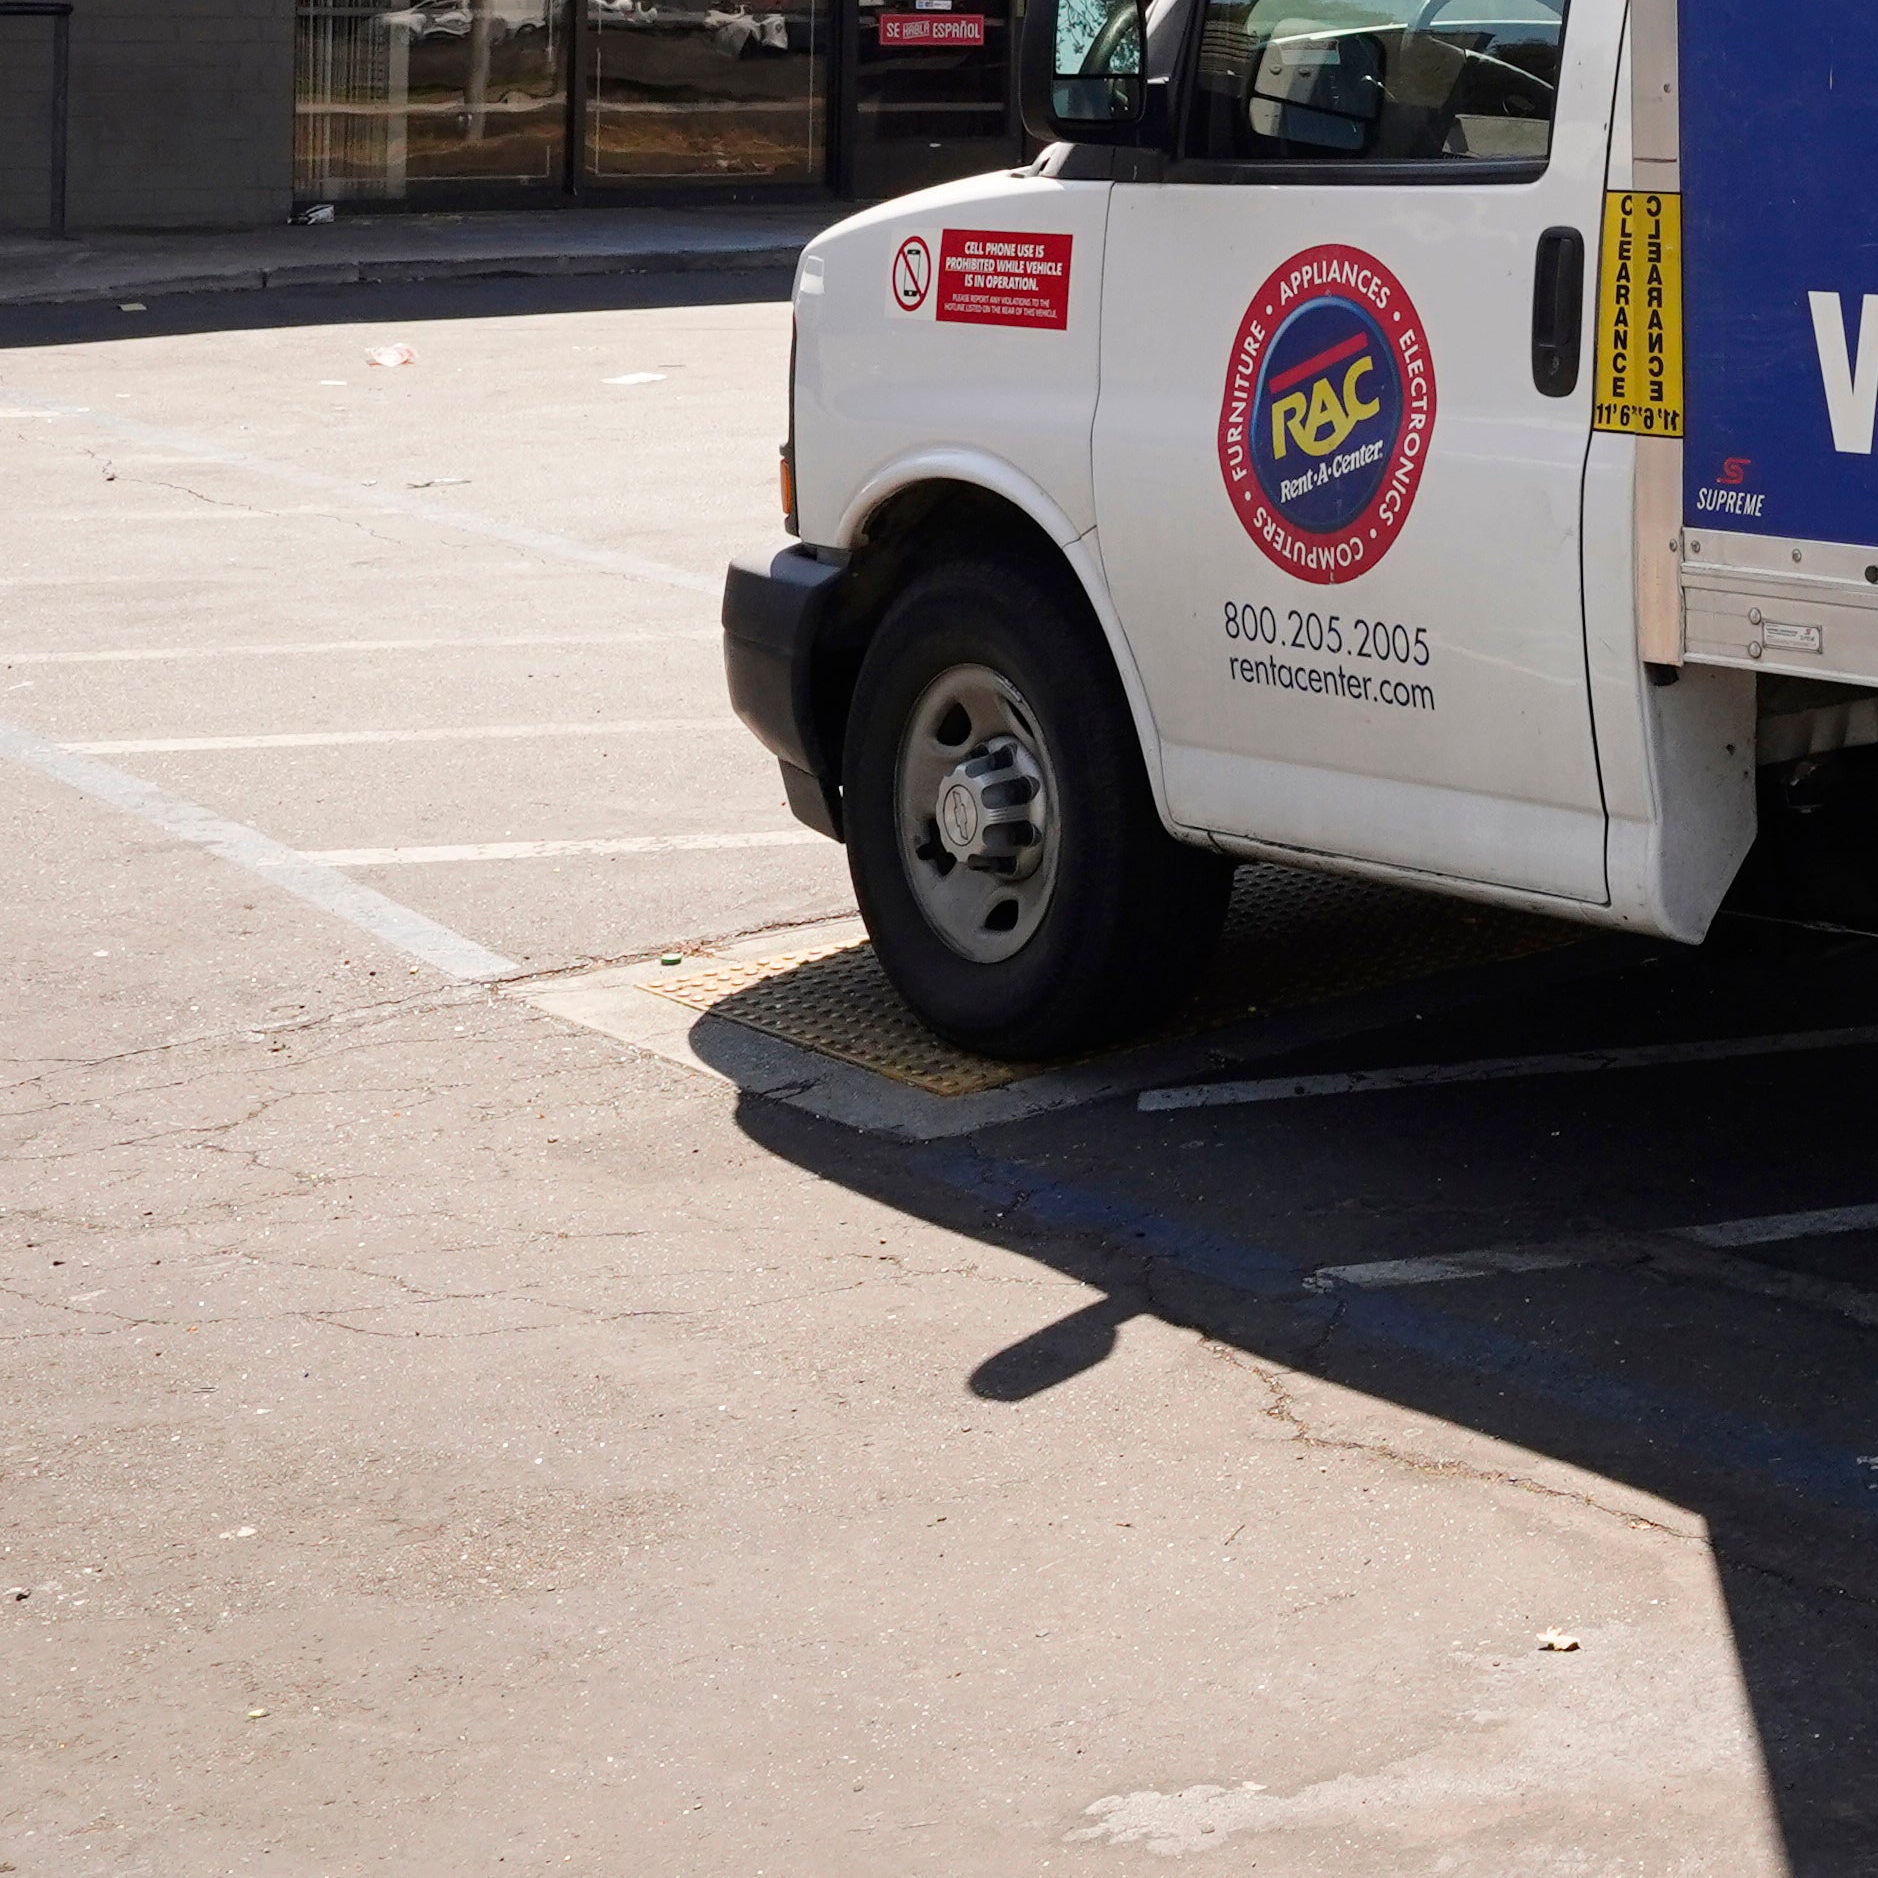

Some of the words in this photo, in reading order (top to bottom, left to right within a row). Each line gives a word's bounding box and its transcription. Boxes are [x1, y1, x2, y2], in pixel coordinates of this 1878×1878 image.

[886, 22, 900, 38] SE
[933, 20, 980, 38] ESPAÑOL
[946, 257, 995, 272] PROHIBITED
[997, 259, 1024, 273] WHILE
[1026, 261, 1062, 275] VEHICLE
[965, 242, 983, 255] CELL
[985, 243, 1015, 256] PHONE
[1017, 244, 1033, 257] USE
[1035, 245, 1044, 258] IS
[965, 274, 973, 287] IS
[974, 275, 984, 287] IN
[985, 275, 1038, 291] OPERATION.
[1279, 259, 1390, 309] APPLIANCES
[1611, 195, 1633, 398] CLEARANCE
[1226, 319, 1266, 482] FURNITURE
[1271, 355, 1380, 460] RAC
[1379, 328, 1428, 526] ELECTRONICS
[1697, 487, 1765, 517] SUPREME
[1253, 506, 1364, 571] COMPUTERS
[1224, 601, 1430, 666] 800.205.2005
[1229, 655, 1435, 710] rentacenter.com
